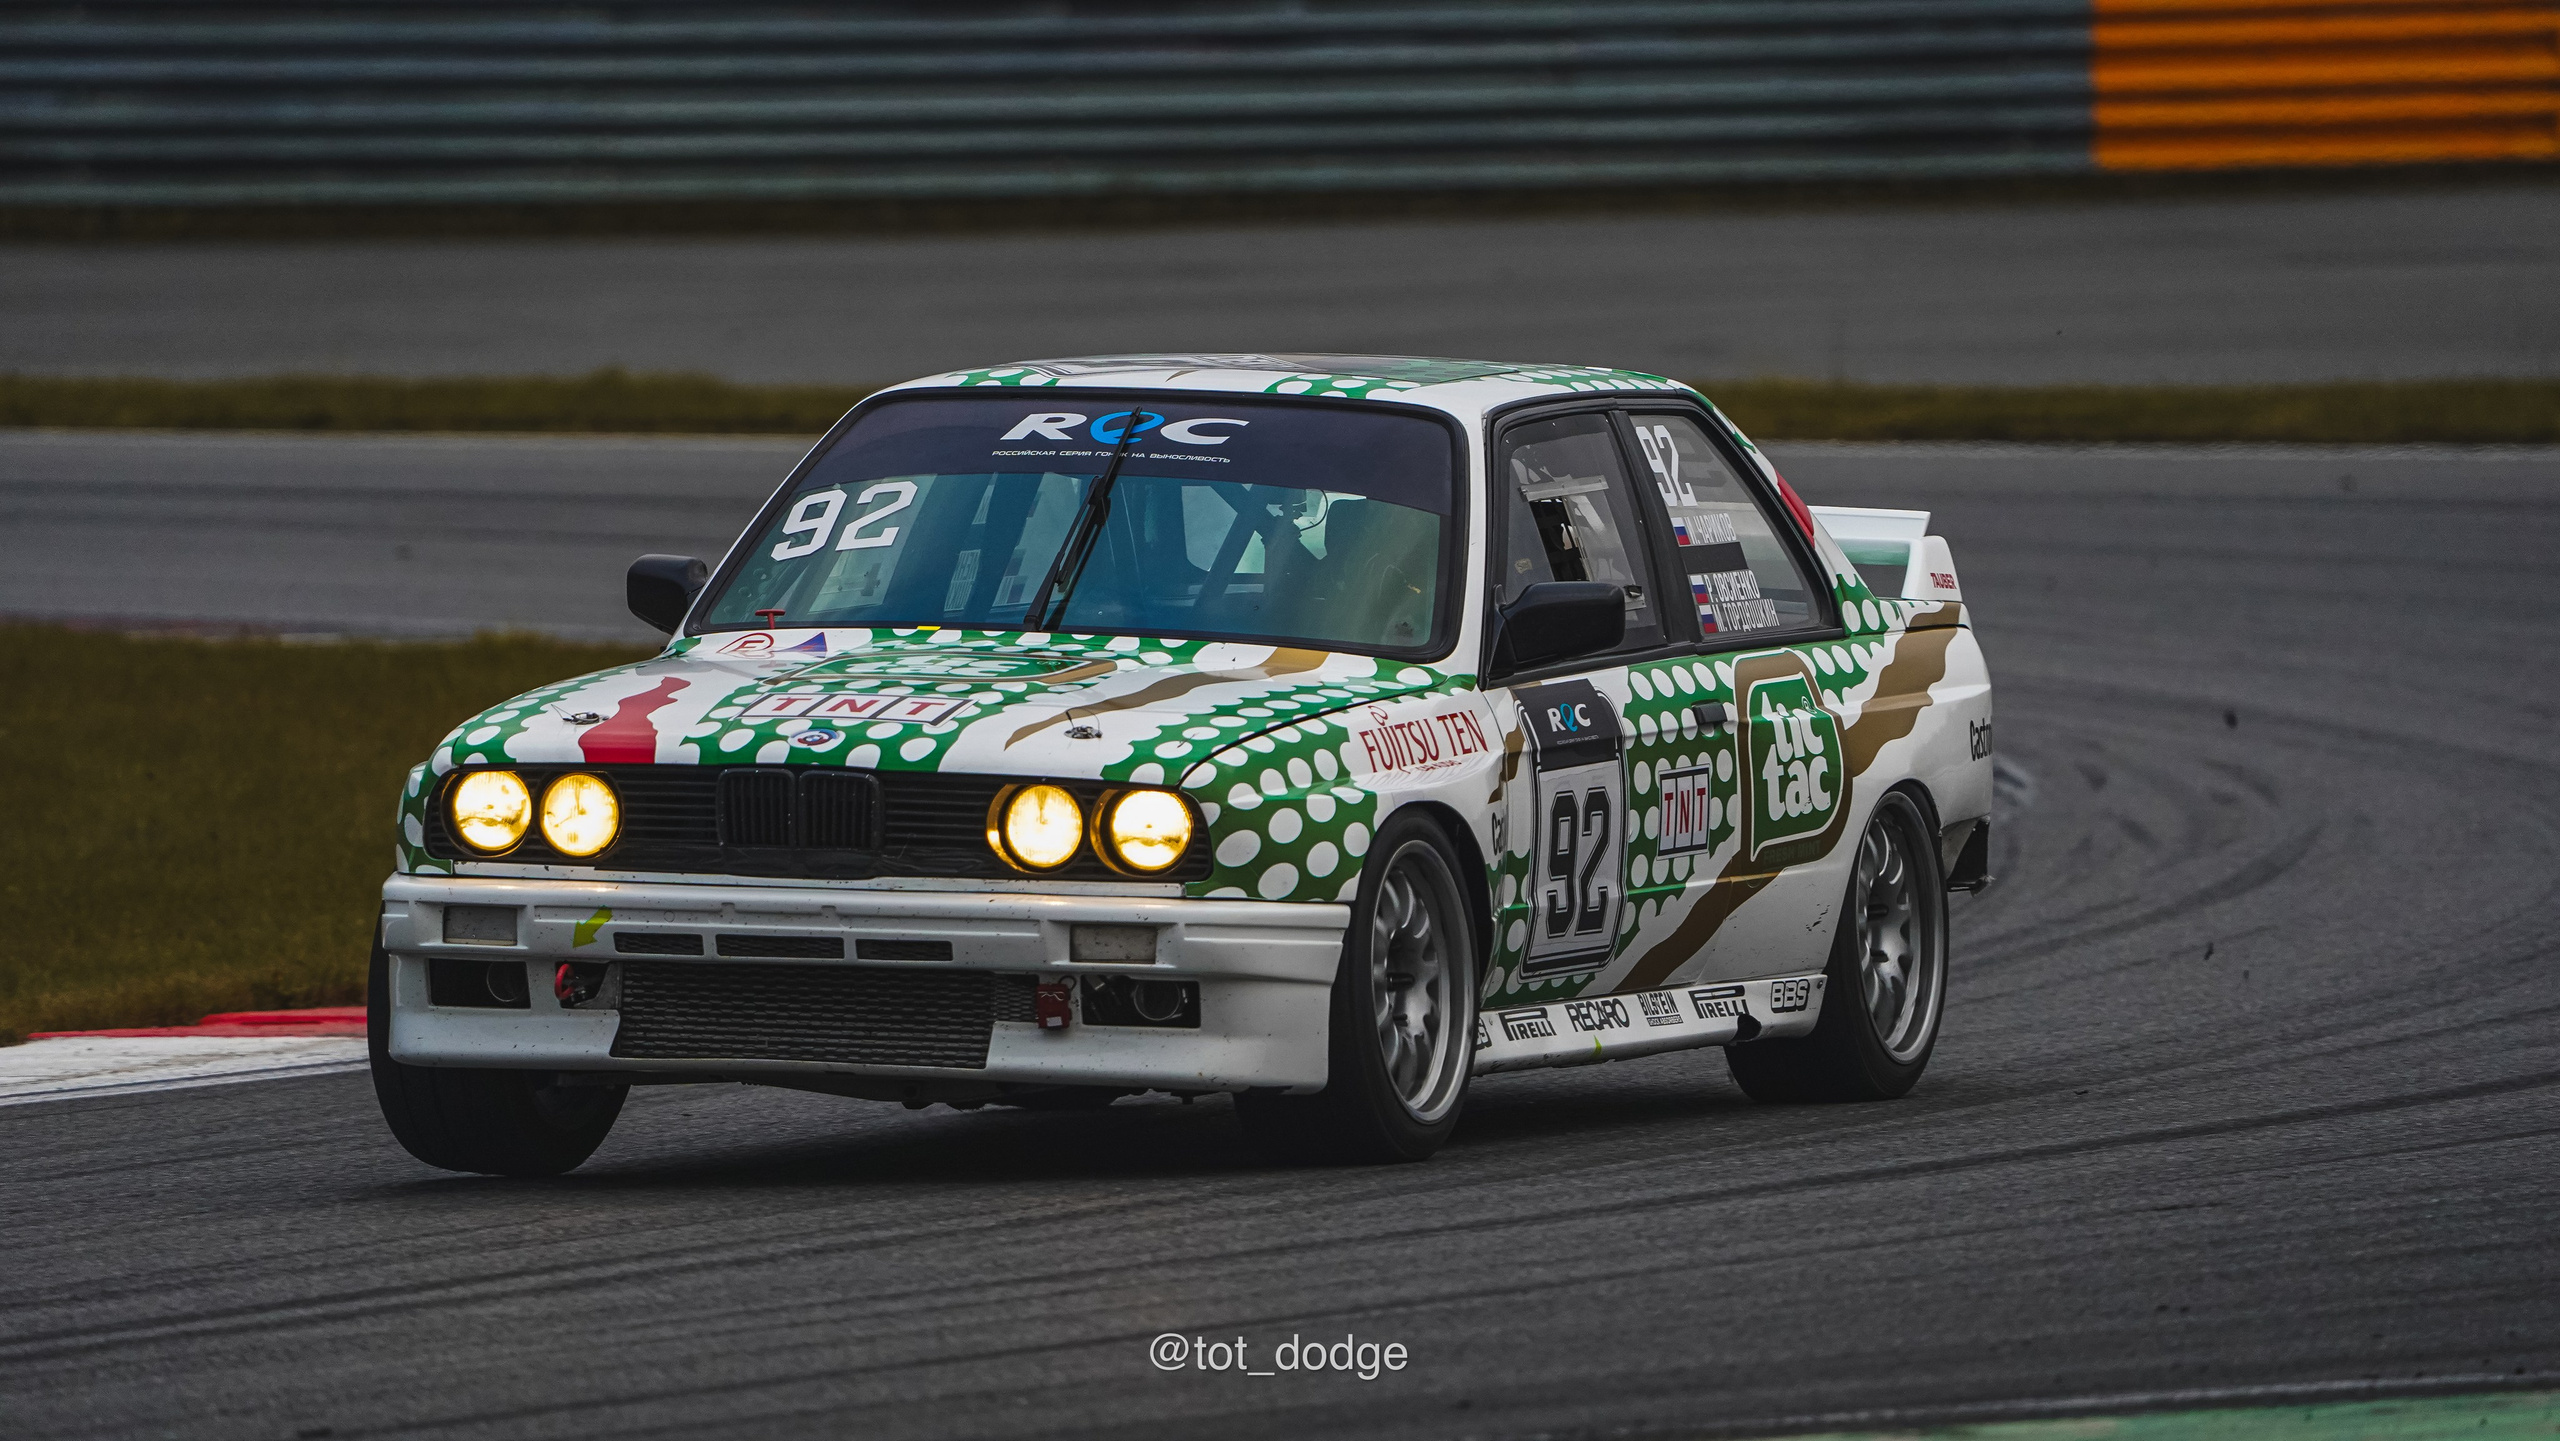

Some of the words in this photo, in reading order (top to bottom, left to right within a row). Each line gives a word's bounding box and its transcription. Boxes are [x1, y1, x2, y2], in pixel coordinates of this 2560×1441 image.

[1095, 451, 1129, 459] ГОНК
[1150, 453, 1231, 463] ВЫНОСЛИВОСТЬ
[1636, 425, 1698, 507] 92
[771, 481, 918, 561] 92
[771, 697, 945, 715] TNT
[1359, 719, 1439, 774] FUJITSU
[1436, 710, 1489, 757] TEN
[1762, 691, 1825, 763] tic
[1762, 744, 1831, 821] tac
[1664, 787, 1706, 836] TNT
[1546, 786, 1611, 939] 92
[1564, 998, 1630, 1032] RECARO
[1637, 990, 1679, 1016] BILSTEIN
[1688, 985, 1750, 1019] PIRELLI
[1771, 979, 1810, 1013] BBS
[1498, 1007, 1557, 1041] PIRELLI
